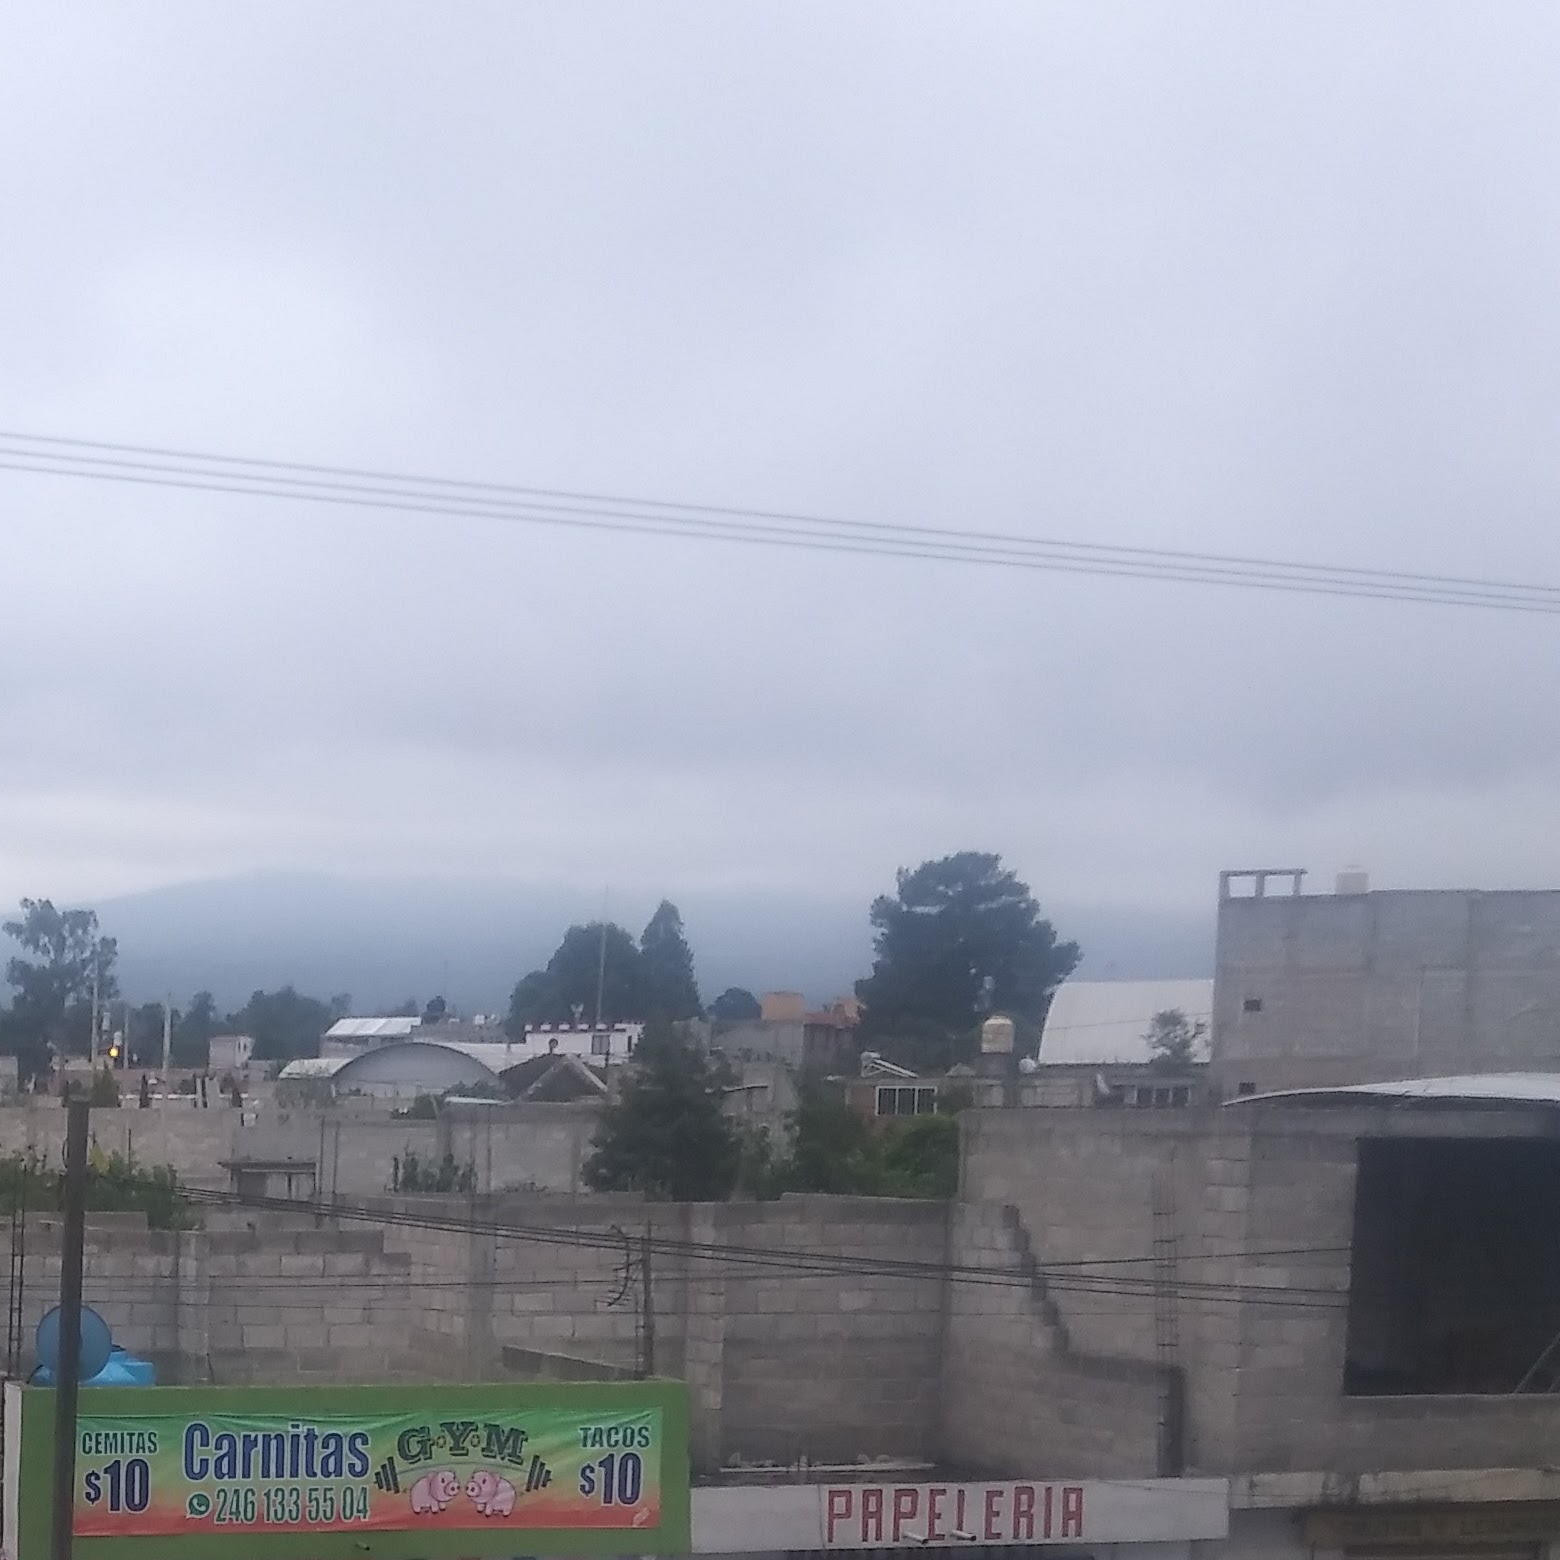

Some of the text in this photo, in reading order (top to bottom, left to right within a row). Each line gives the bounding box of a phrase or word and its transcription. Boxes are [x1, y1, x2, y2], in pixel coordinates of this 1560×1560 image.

[82, 1431, 158, 1455] CEMITAS
[184, 1422, 371, 1481] Carnitas
[579, 1426, 651, 1449] TACOS
[84, 1458, 150, 1513] $10
[215, 1486, 370, 1523] 246 133 55 04
[579, 1451, 642, 1505] $10
[827, 1485, 1085, 1543] PAPELERIA
